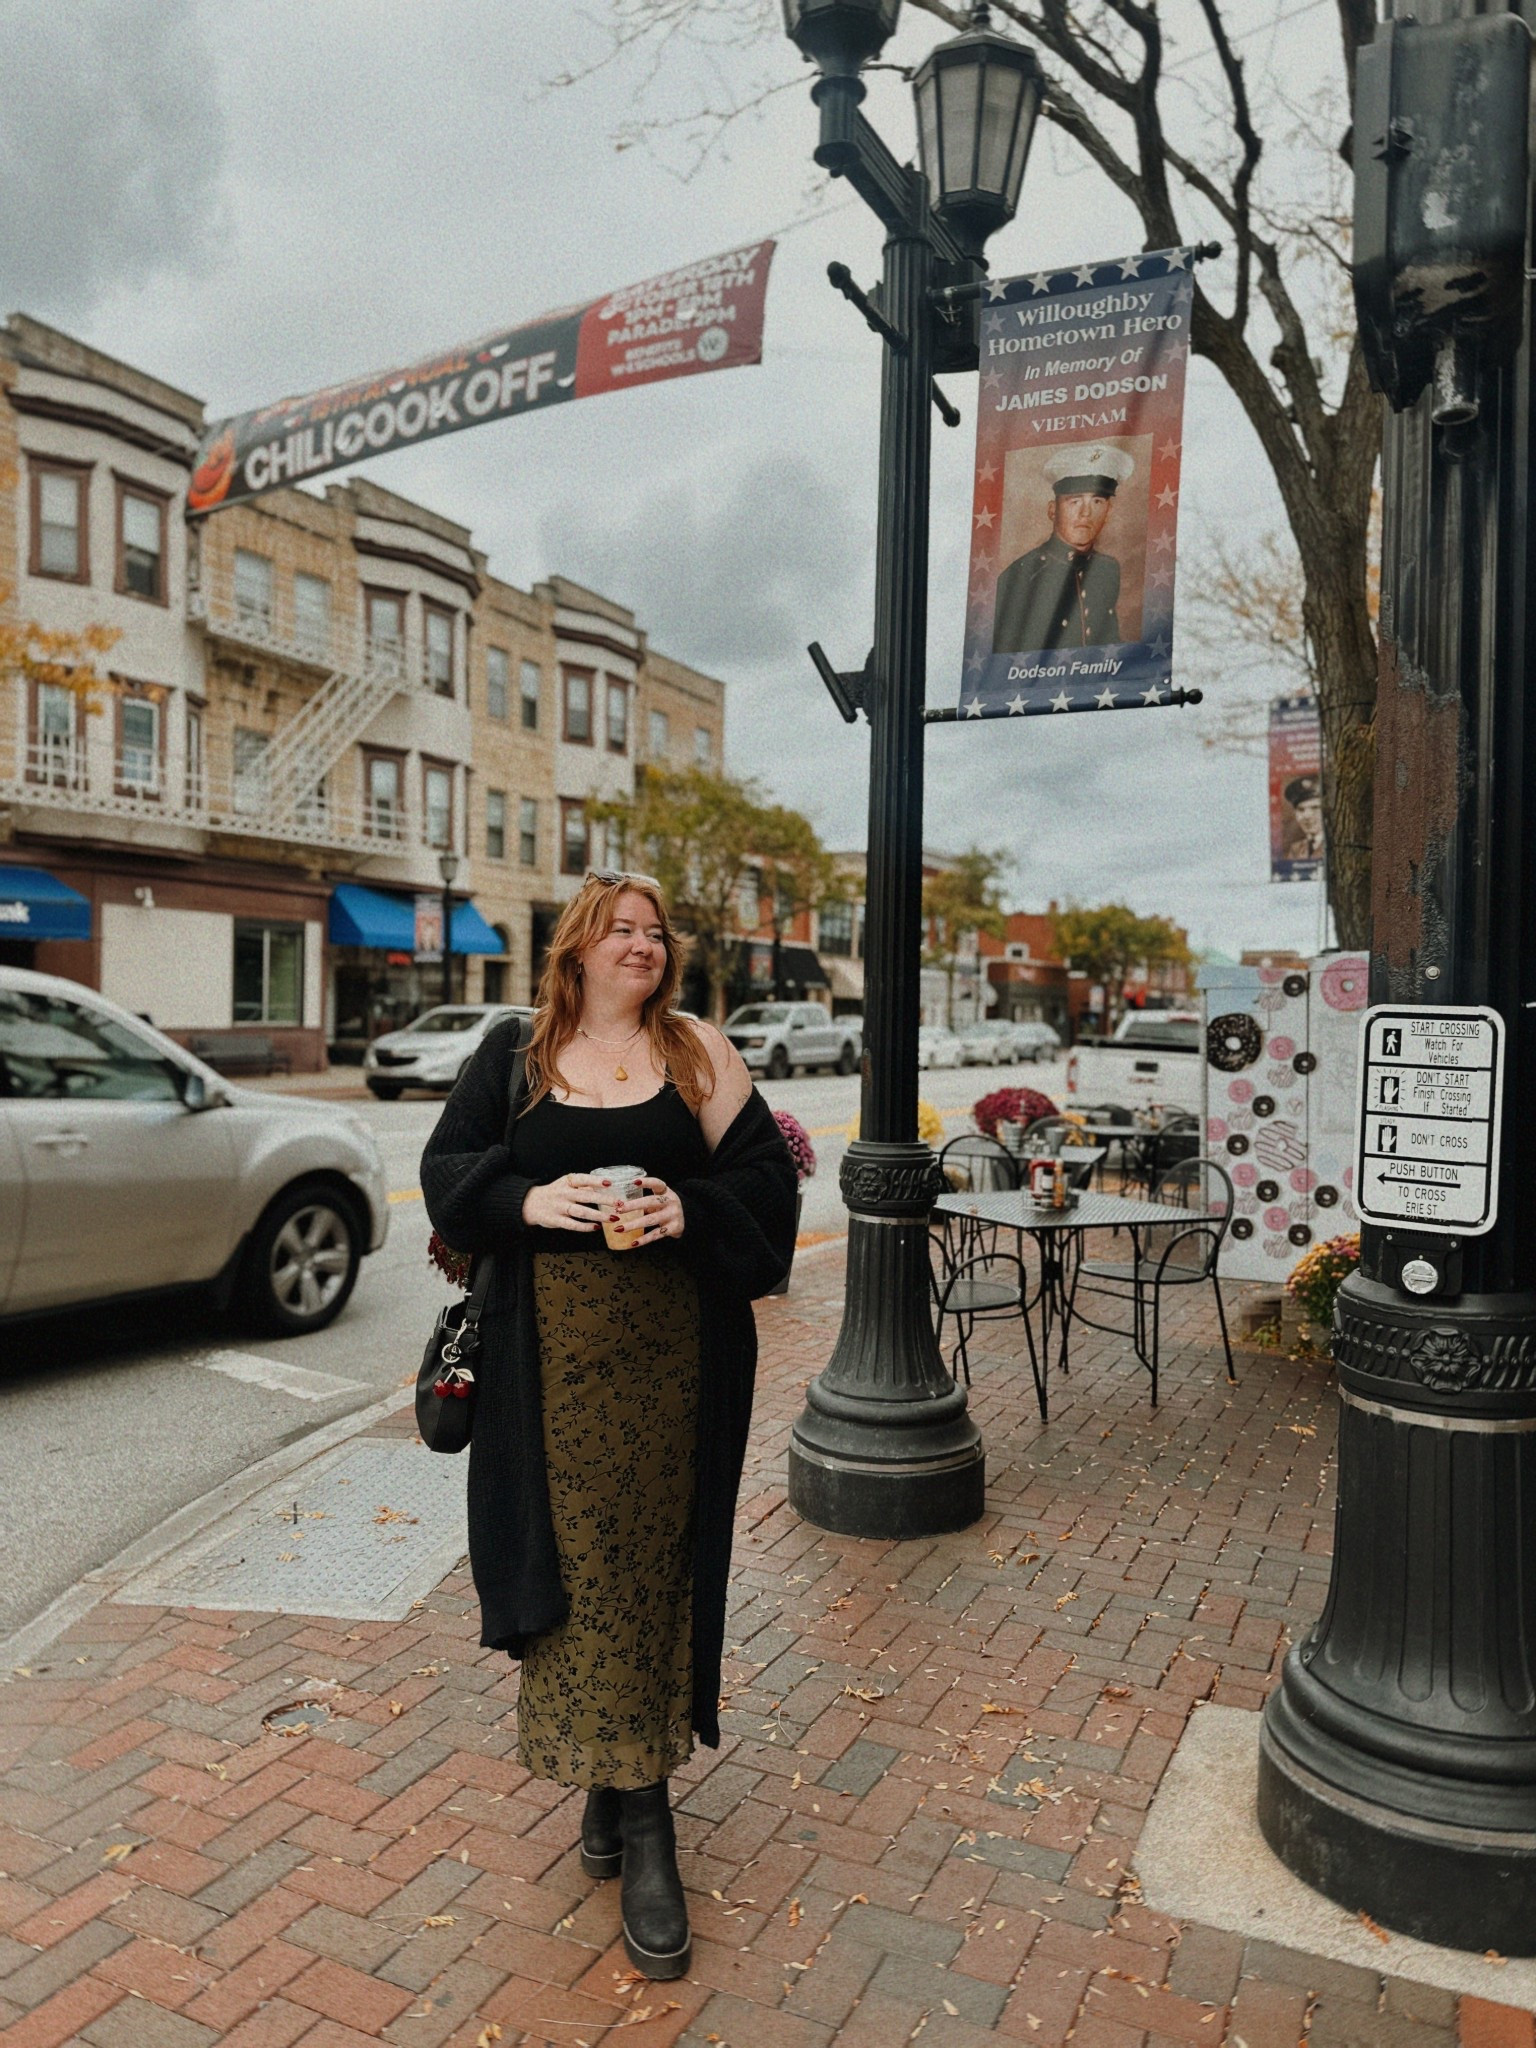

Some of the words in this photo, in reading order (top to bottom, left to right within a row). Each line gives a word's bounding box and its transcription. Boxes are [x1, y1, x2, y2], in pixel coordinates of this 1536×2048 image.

[1016, 292, 1154, 328] Willoughby
[988, 324, 1116, 357] Hometown
[1122, 313, 1182, 336] Hero
[1024, 365, 1041, 381] In
[1044, 355, 1117, 378] Memory
[1120, 347, 1144, 366] Of
[995, 386, 1068, 412] JAMES
[1074, 374, 1168, 402] DODSON
[244, 420, 335, 491] CHILI
[463, 350, 557, 417] OFF
[1032, 407, 1127, 433] VIETNAM
[1007, 662, 1066, 681] Dodson
[1069, 658, 1123, 676] Family
[1410, 1021, 1435, 1034] START
[1439, 1022, 1480, 1036] CROSSING
[1424, 1038, 1447, 1051] Watch
[1451, 1039, 1463, 1051] For
[1428, 1051, 1459, 1065] Vehicles
[1416, 1071, 1440, 1084] DON'T
[1444, 1073, 1469, 1086] START
[1413, 1086, 1435, 1099] Finish
[1440, 1088, 1471, 1106] Crossing
[1423, 1101, 1430, 1113] If
[1441, 1102, 1468, 1116] Started
[1411, 1132, 1435, 1146] DON'T
[1440, 1135, 1468, 1149] CROSS
[1389, 1162, 1415, 1177] PUSH
[1420, 1165, 1458, 1181] BUTTON
[1398, 1185, 1410, 1198] TO
[1414, 1187, 1447, 1202] CROSS
[1405, 1201, 1424, 1215] ERIE
[1426, 1204, 1438, 1216] ST
